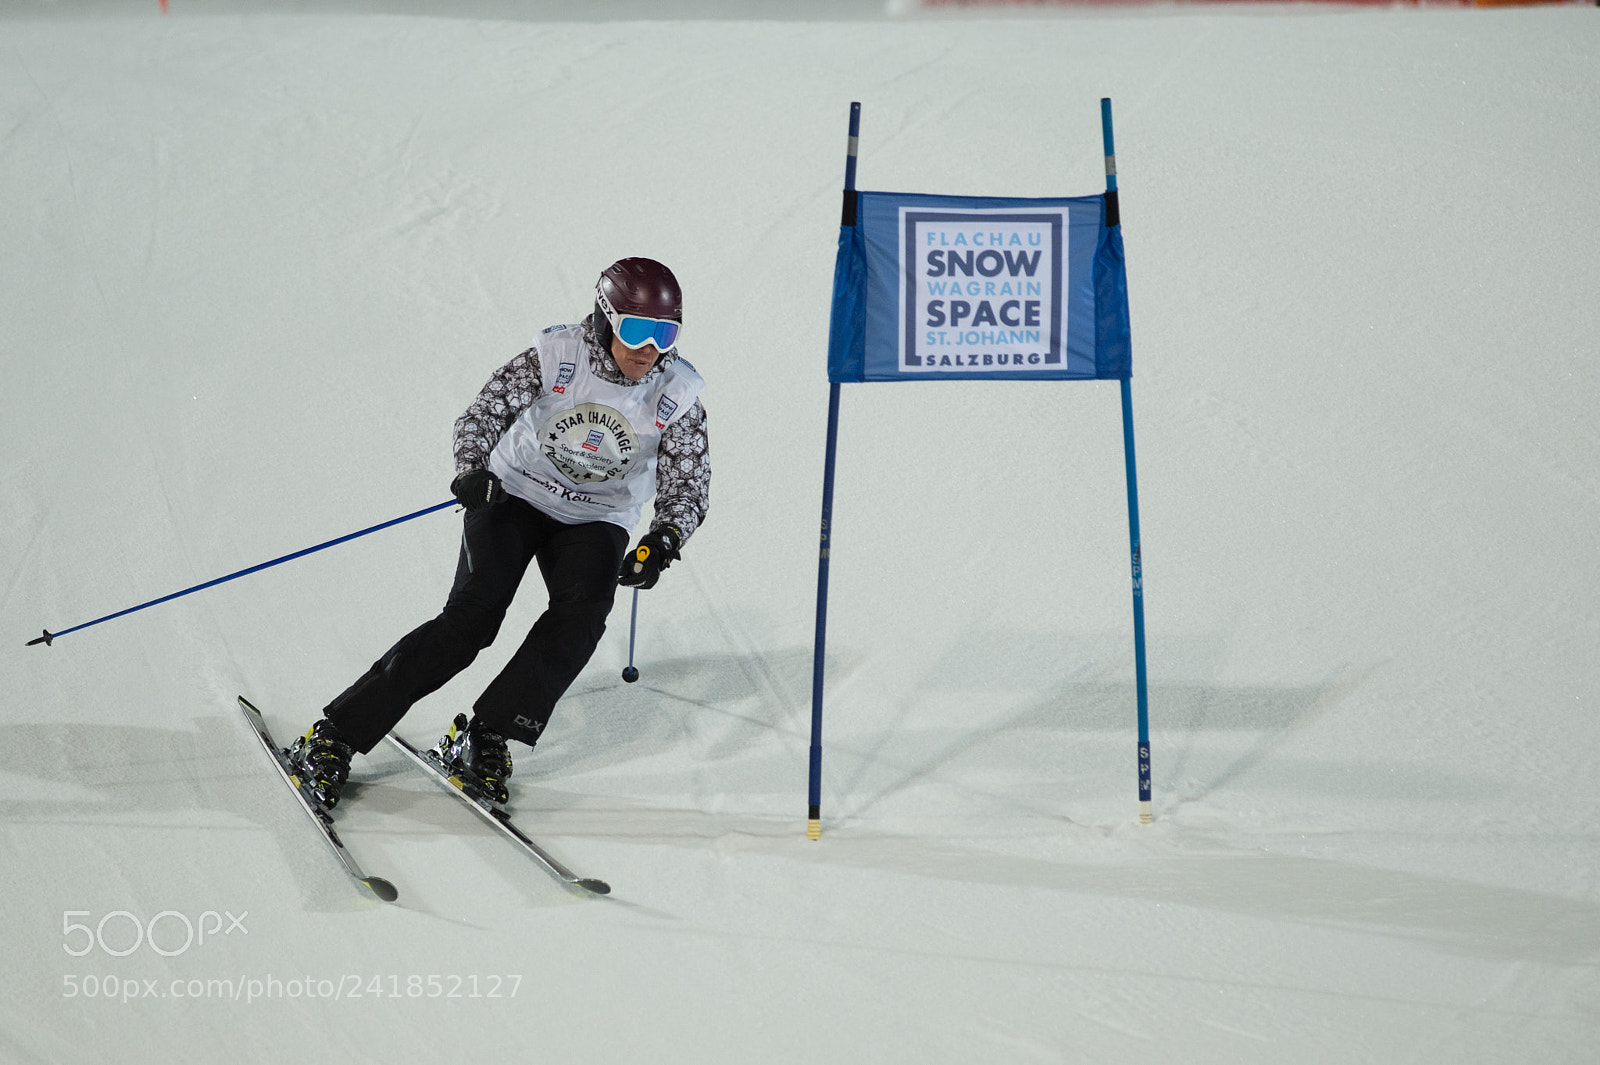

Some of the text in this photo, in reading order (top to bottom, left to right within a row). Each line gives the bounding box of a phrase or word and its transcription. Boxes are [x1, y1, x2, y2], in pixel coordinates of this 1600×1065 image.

[927, 232, 1041, 247] FLACHAU
[926, 249, 1042, 278] SNOW
[927, 281, 1041, 296] WAGRAIN
[926, 300, 1041, 327] SPACE
[926, 330, 1040, 346] ST. JOHANN
[926, 353, 1040, 367] SALZBURG
[555, 411, 632, 454] STAR CHALLENGE
[560, 443, 580, 457] Sport
[586, 452, 615, 466] Society
